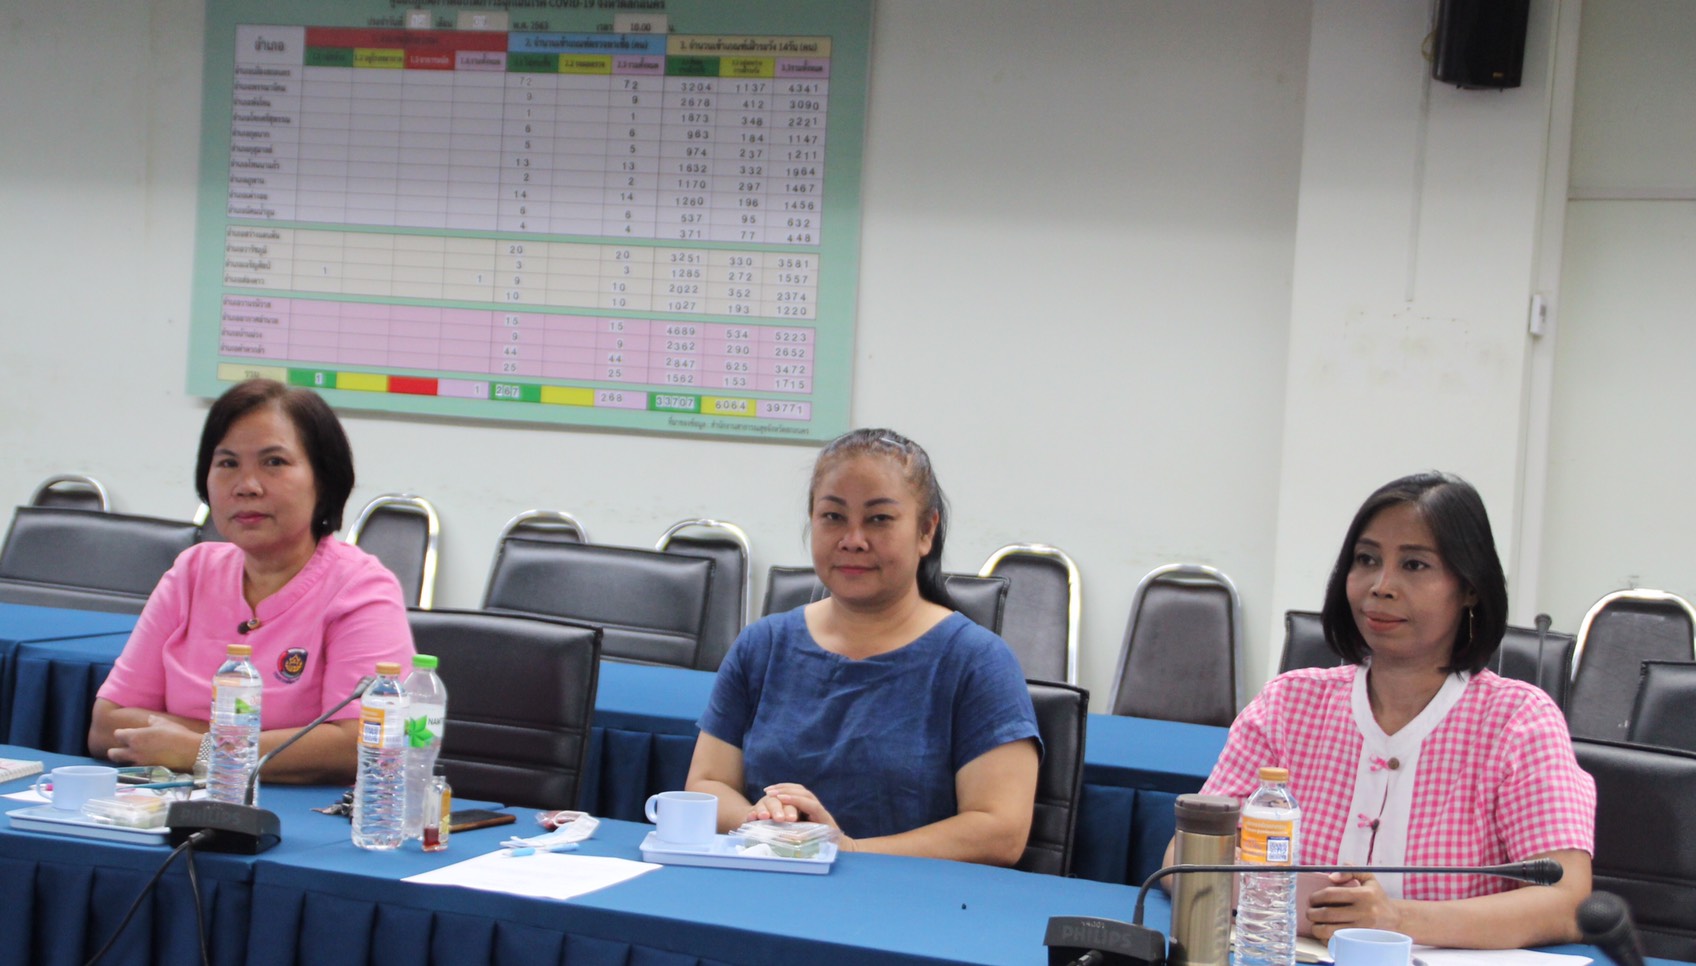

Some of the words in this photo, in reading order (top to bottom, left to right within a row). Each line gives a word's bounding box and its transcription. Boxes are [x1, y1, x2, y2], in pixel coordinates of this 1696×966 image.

[510, 246, 523, 255] 20
[615, 251, 630, 260] 20
[671, 253, 701, 263] 3251
[729, 257, 752, 267] 330
[778, 258, 809, 268] 3581
[672, 269, 700, 278] 1285
[728, 271, 752, 281] 272
[778, 274, 808, 284] 1557
[612, 283, 625, 292] 10
[669, 285, 699, 295] 2022
[728, 287, 750, 298] 352
[506, 292, 519, 301] 10
[777, 292, 807, 302] 2374
[612, 298, 625, 307] 10
[668, 301, 696, 310] 1027
[728, 304, 750, 315] 193
[776, 306, 807, 316] 1220
[505, 317, 518, 326] 15
[609, 322, 623, 331] 15
[667, 326, 695, 336] 4689
[726, 329, 749, 339] 534
[775, 332, 807, 342] 5223
[666, 341, 695, 351] 2362
[726, 345, 750, 355] 290
[504, 347, 517, 356] 44
[775, 348, 806, 358] 2652
[608, 354, 622, 363] 44
[666, 358, 694, 369] 2847
[503, 363, 517, 372] 25
[726, 362, 748, 372] 625
[775, 365, 806, 375] 3472
[608, 369, 621, 378] 25
[666, 374, 694, 384] 1562
[724, 377, 746, 387] 153
[775, 379, 805, 389] 1715
[495, 386, 519, 396] 267
[600, 393, 623, 402] 268
[656, 396, 695, 407] 33707
[715, 400, 746, 410] 6064
[766, 403, 802, 414] 39771
[1062, 924, 1132, 946] PHILIPS
